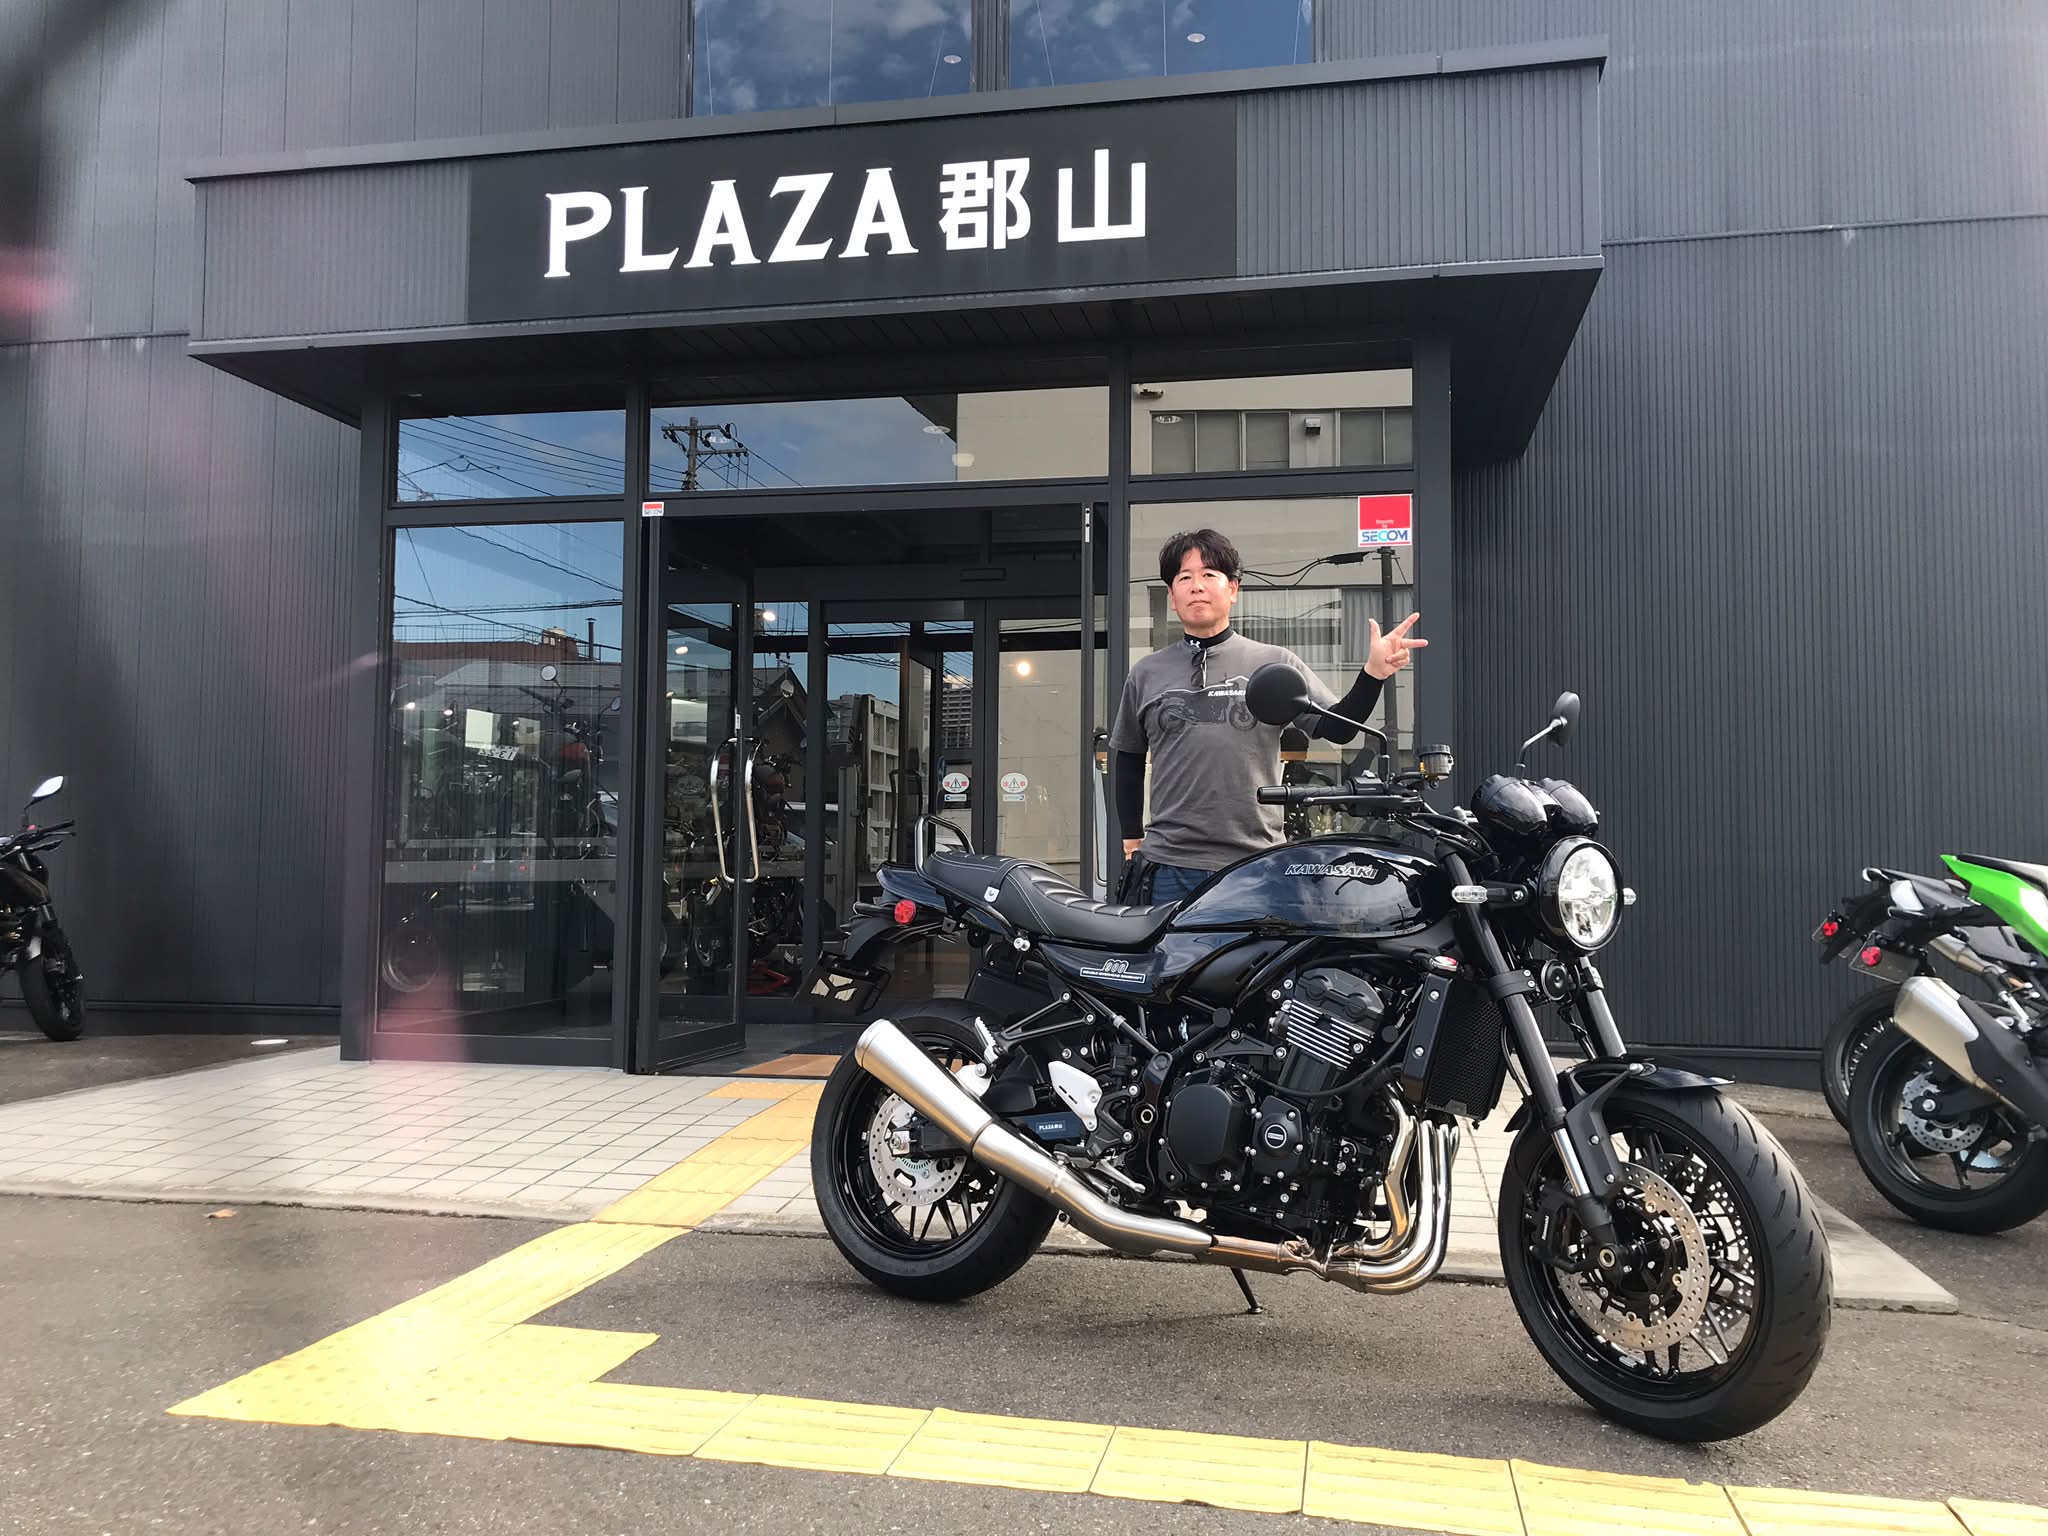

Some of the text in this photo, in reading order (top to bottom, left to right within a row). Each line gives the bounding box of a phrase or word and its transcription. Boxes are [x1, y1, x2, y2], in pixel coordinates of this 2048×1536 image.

[544, 149, 1145, 277] PLAZA 郡山
[1362, 530, 1408, 542] SECOM
[1285, 864, 1378, 879] KAWASAKI
